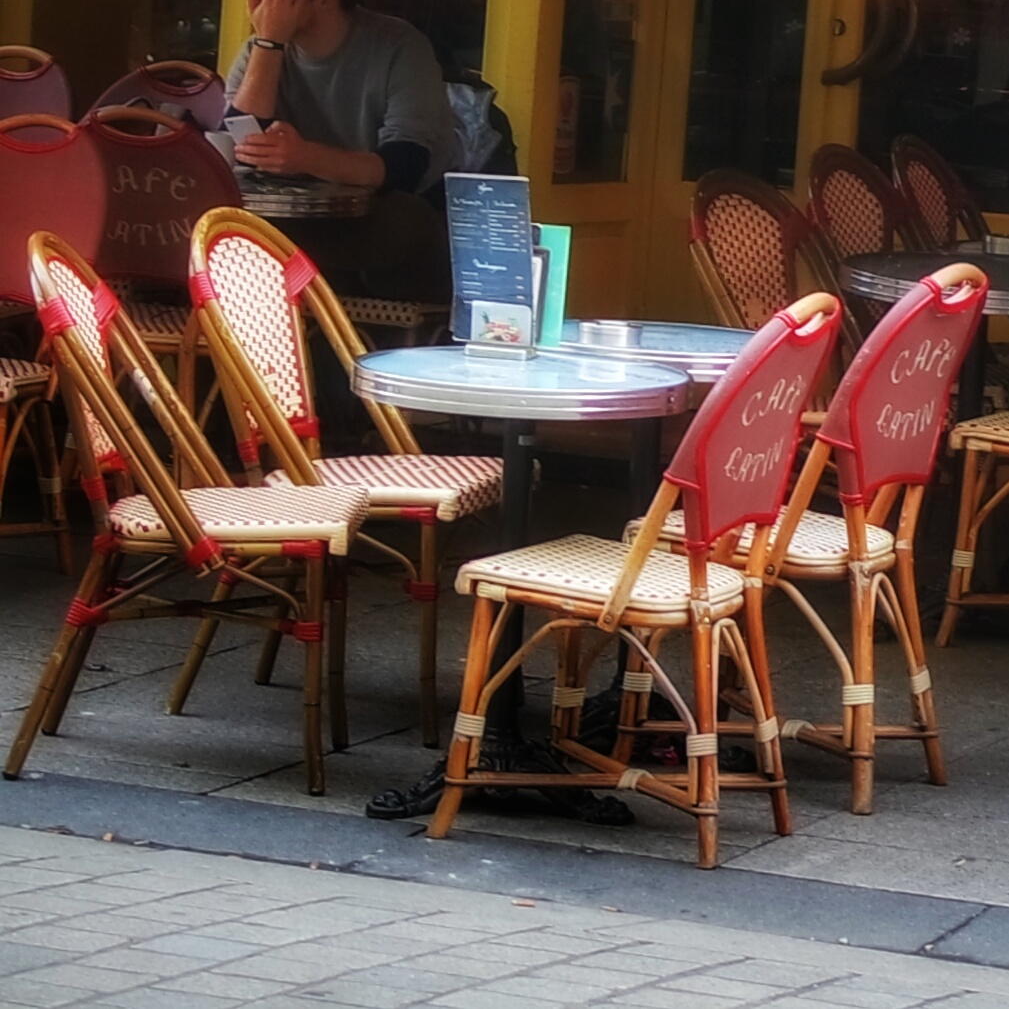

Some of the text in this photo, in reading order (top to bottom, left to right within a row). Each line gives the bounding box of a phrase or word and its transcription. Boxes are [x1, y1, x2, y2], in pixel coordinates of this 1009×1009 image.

[112, 165, 198, 202] AFE
[106, 217, 192, 246] ATIN
[890, 338, 957, 384] CAFE
[876, 399, 936, 441] LATIN
